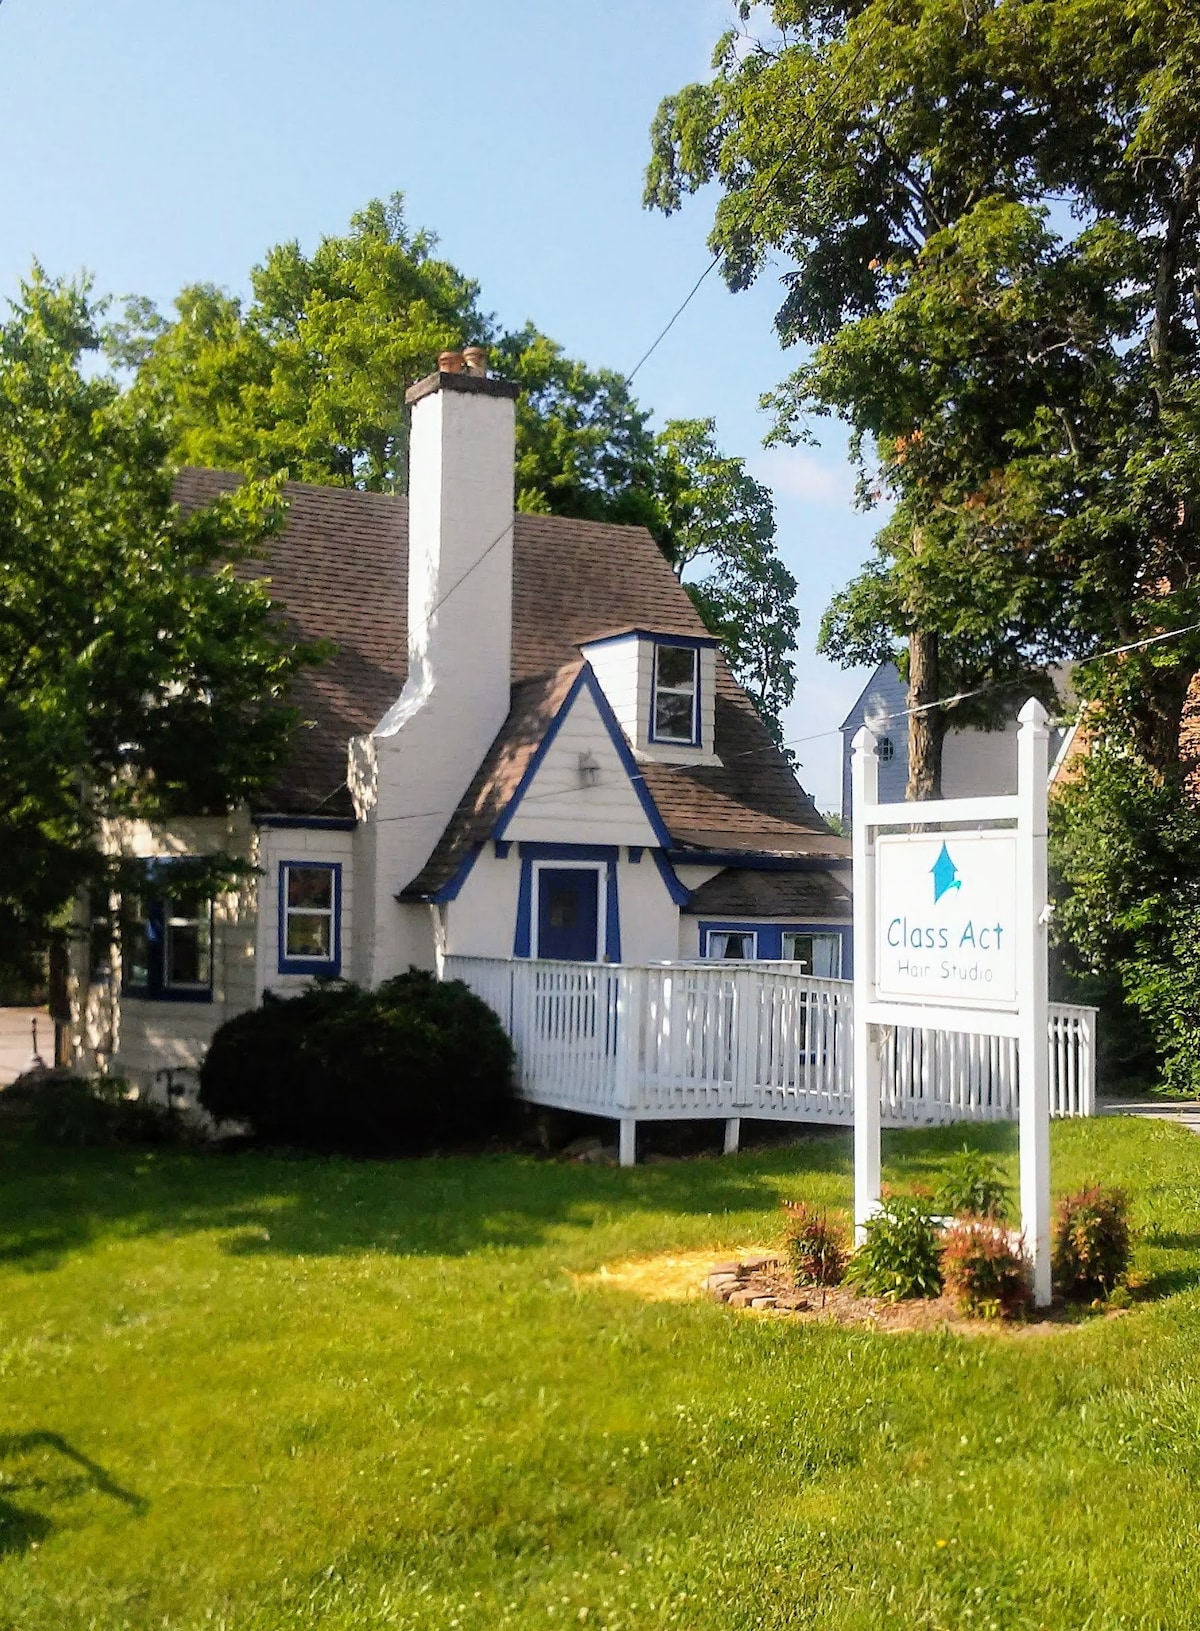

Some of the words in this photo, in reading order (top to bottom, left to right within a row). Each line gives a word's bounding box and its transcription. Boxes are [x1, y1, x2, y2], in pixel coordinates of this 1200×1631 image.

[887, 916, 949, 949] Class
[959, 919, 1004, 951] Act
[898, 959, 930, 978] Hair
[940, 960, 993, 982] Studio
